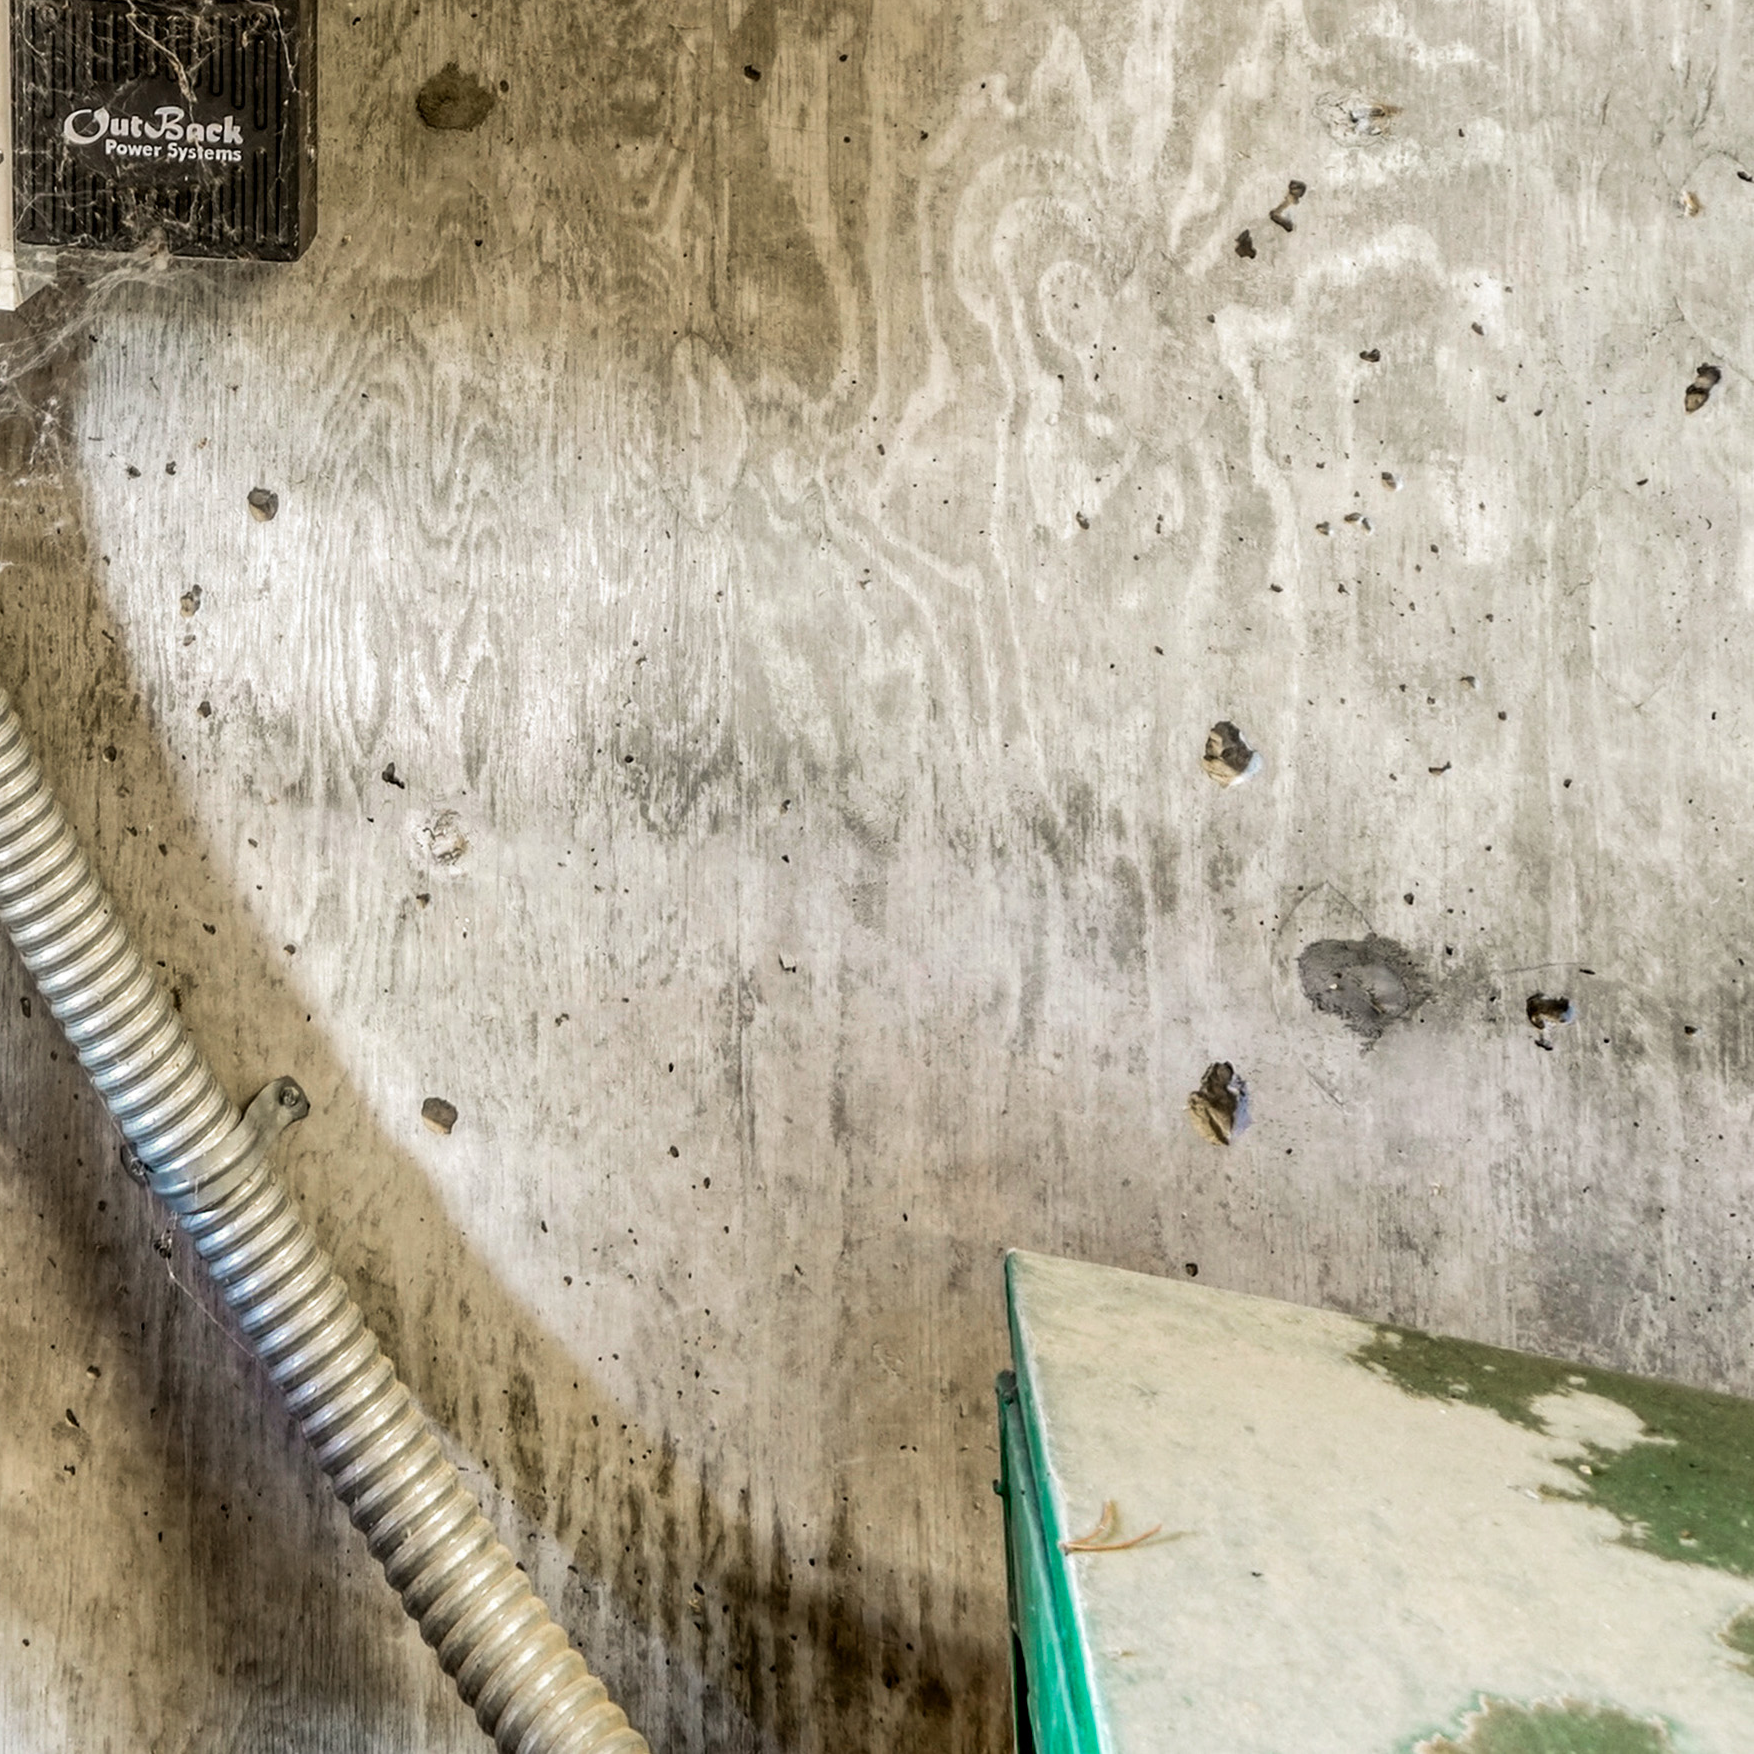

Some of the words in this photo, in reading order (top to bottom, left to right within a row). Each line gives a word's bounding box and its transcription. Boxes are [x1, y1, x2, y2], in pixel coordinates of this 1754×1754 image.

[63, 106, 244, 145] OutBack
[105, 139, 162, 157] Power
[167, 142, 243, 162] Systems
